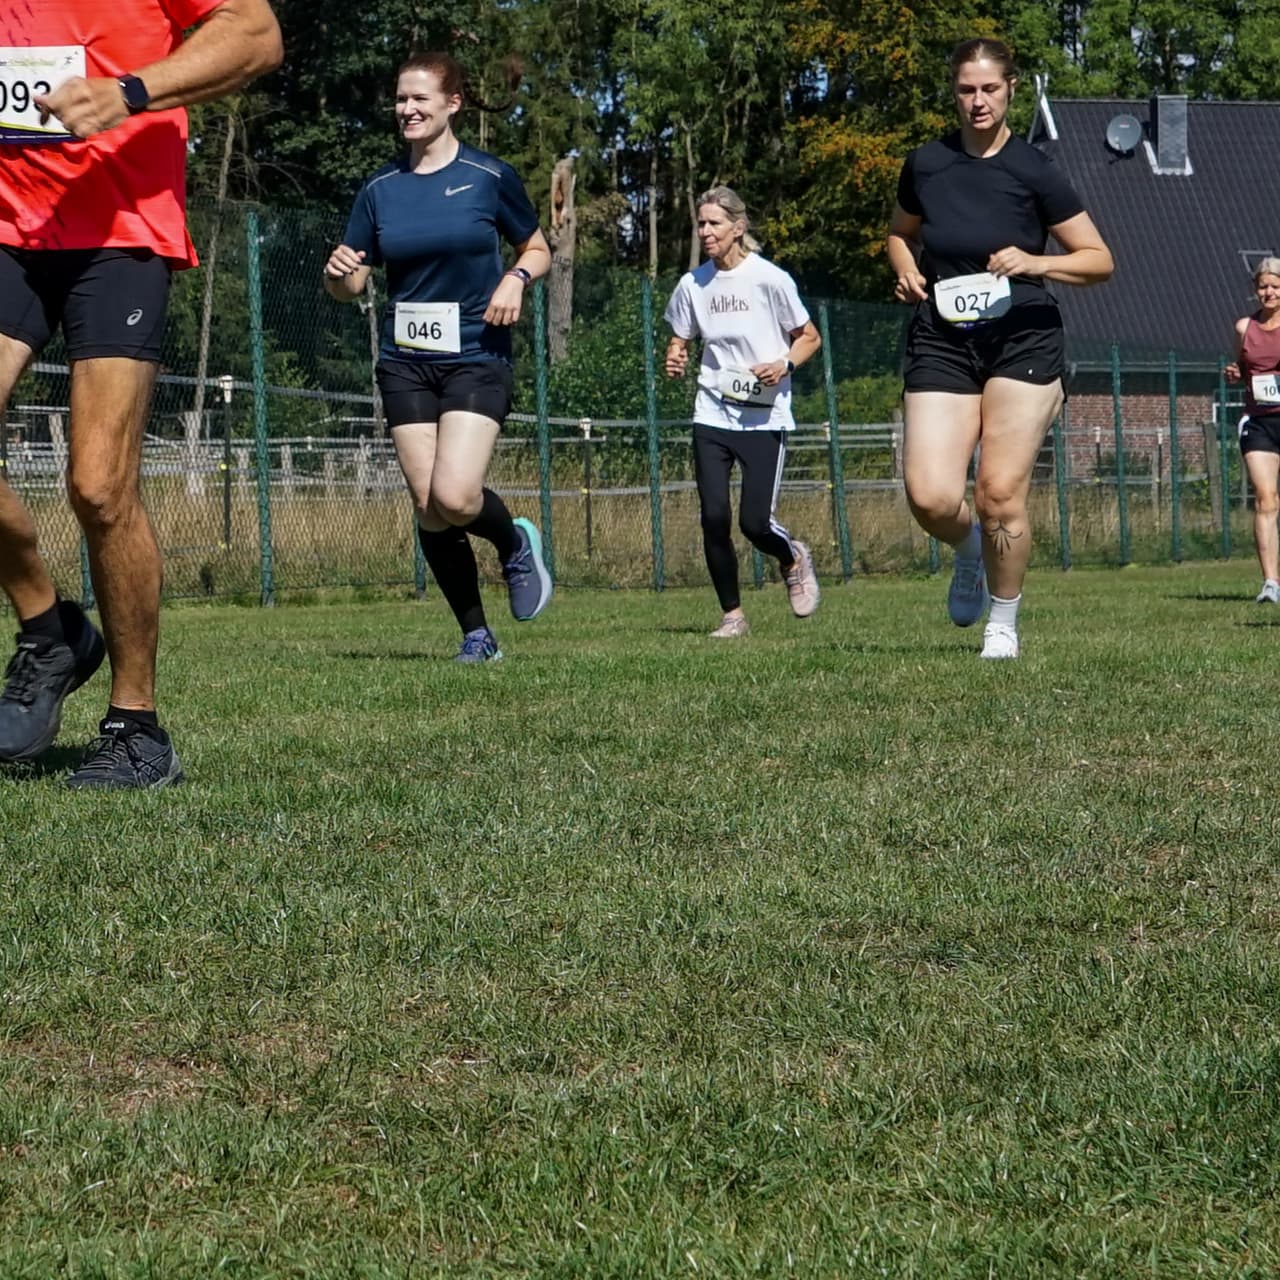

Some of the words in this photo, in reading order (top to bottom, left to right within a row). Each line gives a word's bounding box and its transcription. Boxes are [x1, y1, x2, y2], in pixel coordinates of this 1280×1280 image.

[954, 291, 992, 313] 027
[407, 321, 442, 340] 046
[732, 378, 762, 396] 045
